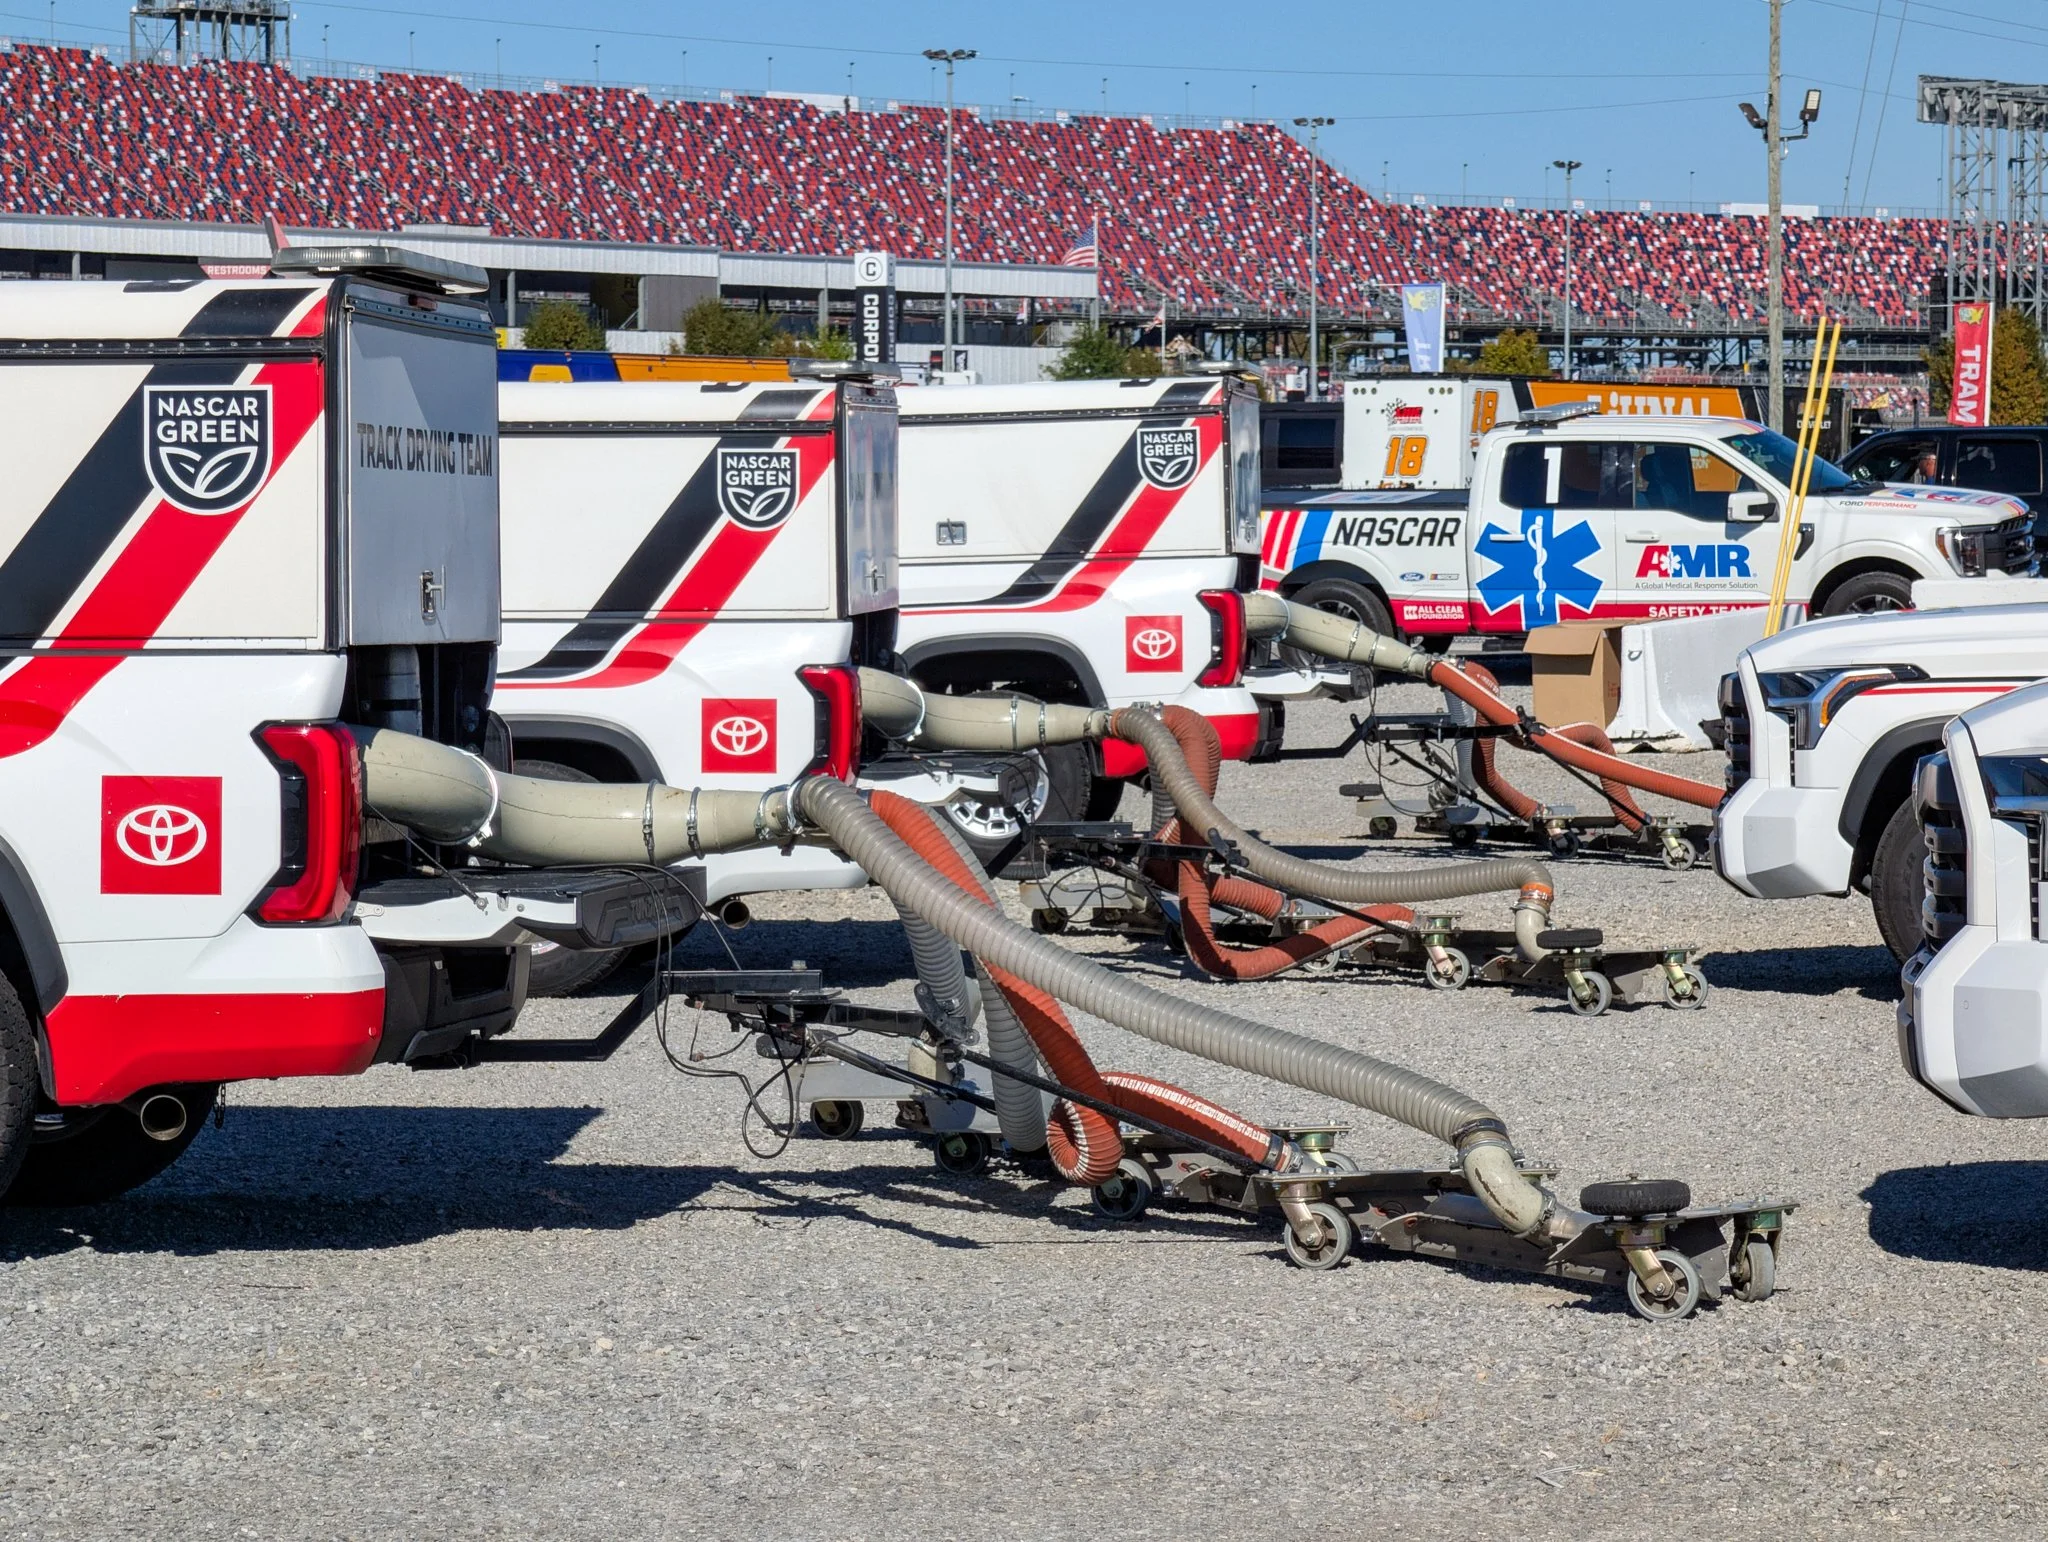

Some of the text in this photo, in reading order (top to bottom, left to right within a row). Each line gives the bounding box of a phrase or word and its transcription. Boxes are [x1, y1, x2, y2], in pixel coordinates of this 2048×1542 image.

[207, 265, 267, 275] RESTROOMS
[866, 262, 876, 276] C
[1955, 344, 1982, 424] TRAM
[157, 396, 259, 417] NASCAR
[1469, 390, 1499, 435] 18
[157, 420, 260, 443] GREEN
[1144, 432, 1193, 444] NASCAR
[357, 423, 492, 477] TRACK DRYING TEAM
[1144, 444, 1194, 456] GREEN
[1384, 434, 1428, 478] 18
[726, 456, 792, 470] NASCAR
[726, 471, 792, 486] GREEN
[1543, 446, 1562, 504] 1
[1332, 517, 1461, 547] NASCAR
[1635, 544, 1752, 578] AMR
[1694, 582, 1727, 590] Response
[1418, 605, 1463, 614] ALL CLEAR
[1648, 606, 1704, 617] SAFETY
